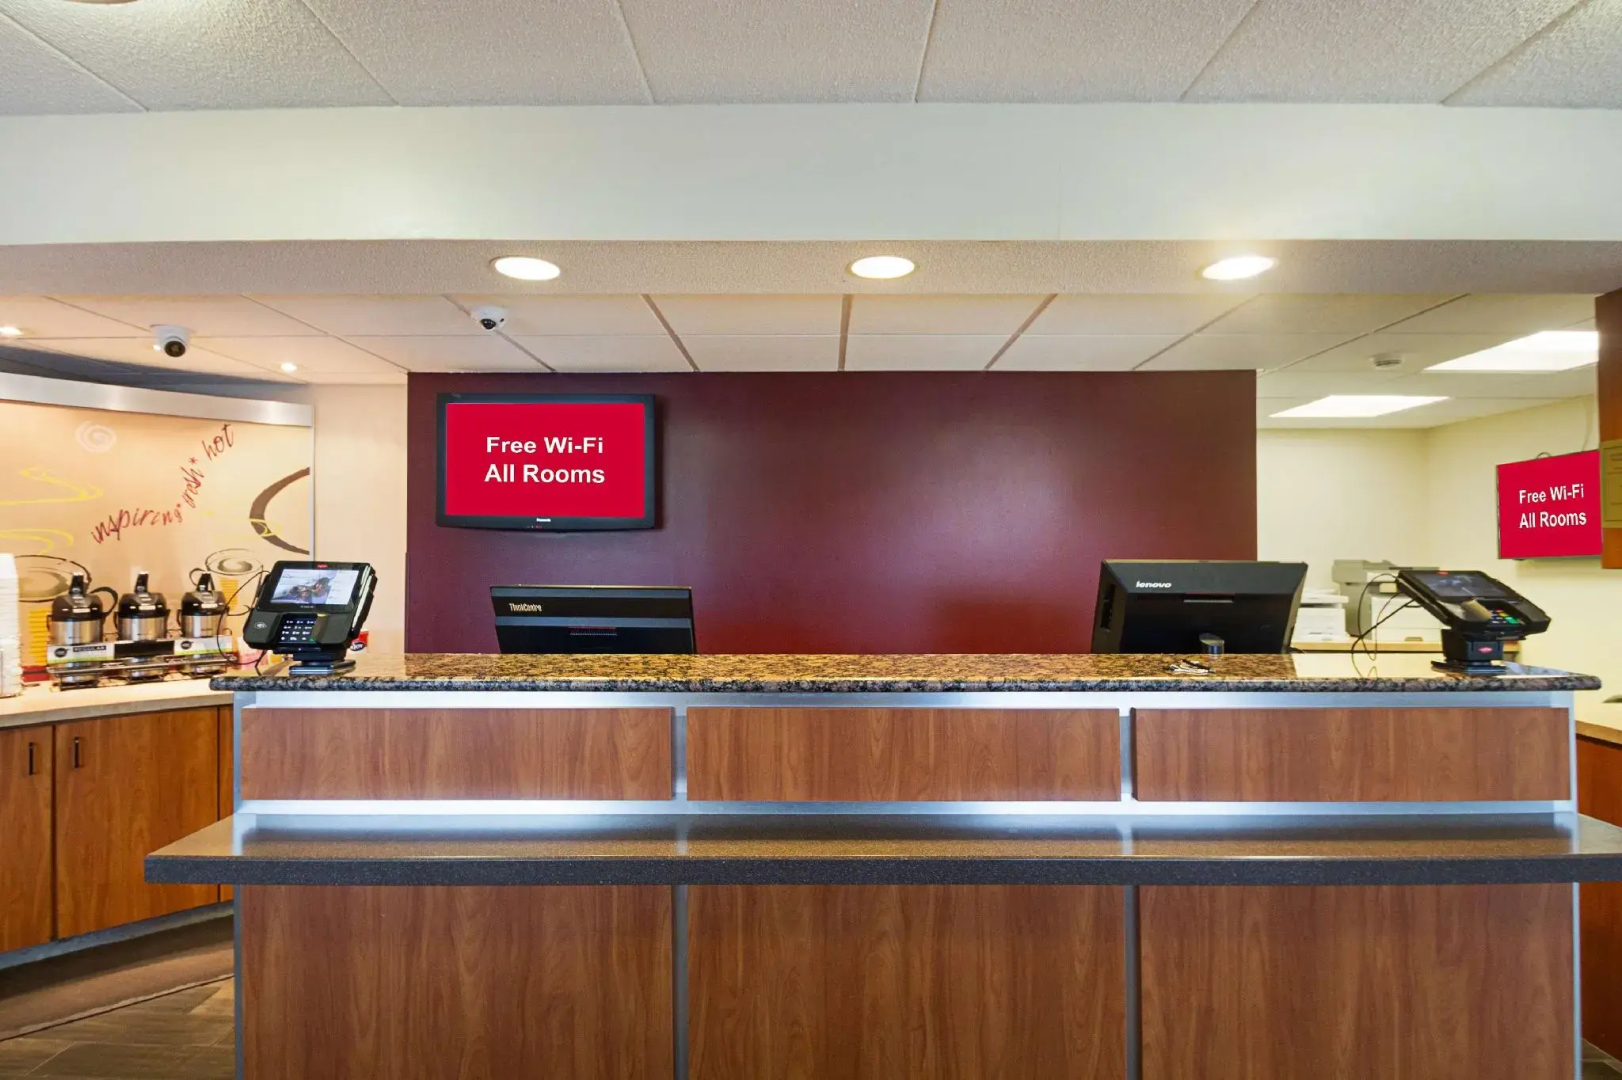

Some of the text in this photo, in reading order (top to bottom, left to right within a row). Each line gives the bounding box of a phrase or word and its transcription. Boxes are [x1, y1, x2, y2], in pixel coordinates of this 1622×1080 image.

[201, 423, 234, 461] hot
[486, 436, 603, 454] Free Wi-Fi
[484, 463, 605, 484] All Rooms
[1518, 483, 1584, 504] Free Wi-Fi
[1519, 511, 1587, 529] All Rooms
[1135, 580, 1172, 589] lenovo
